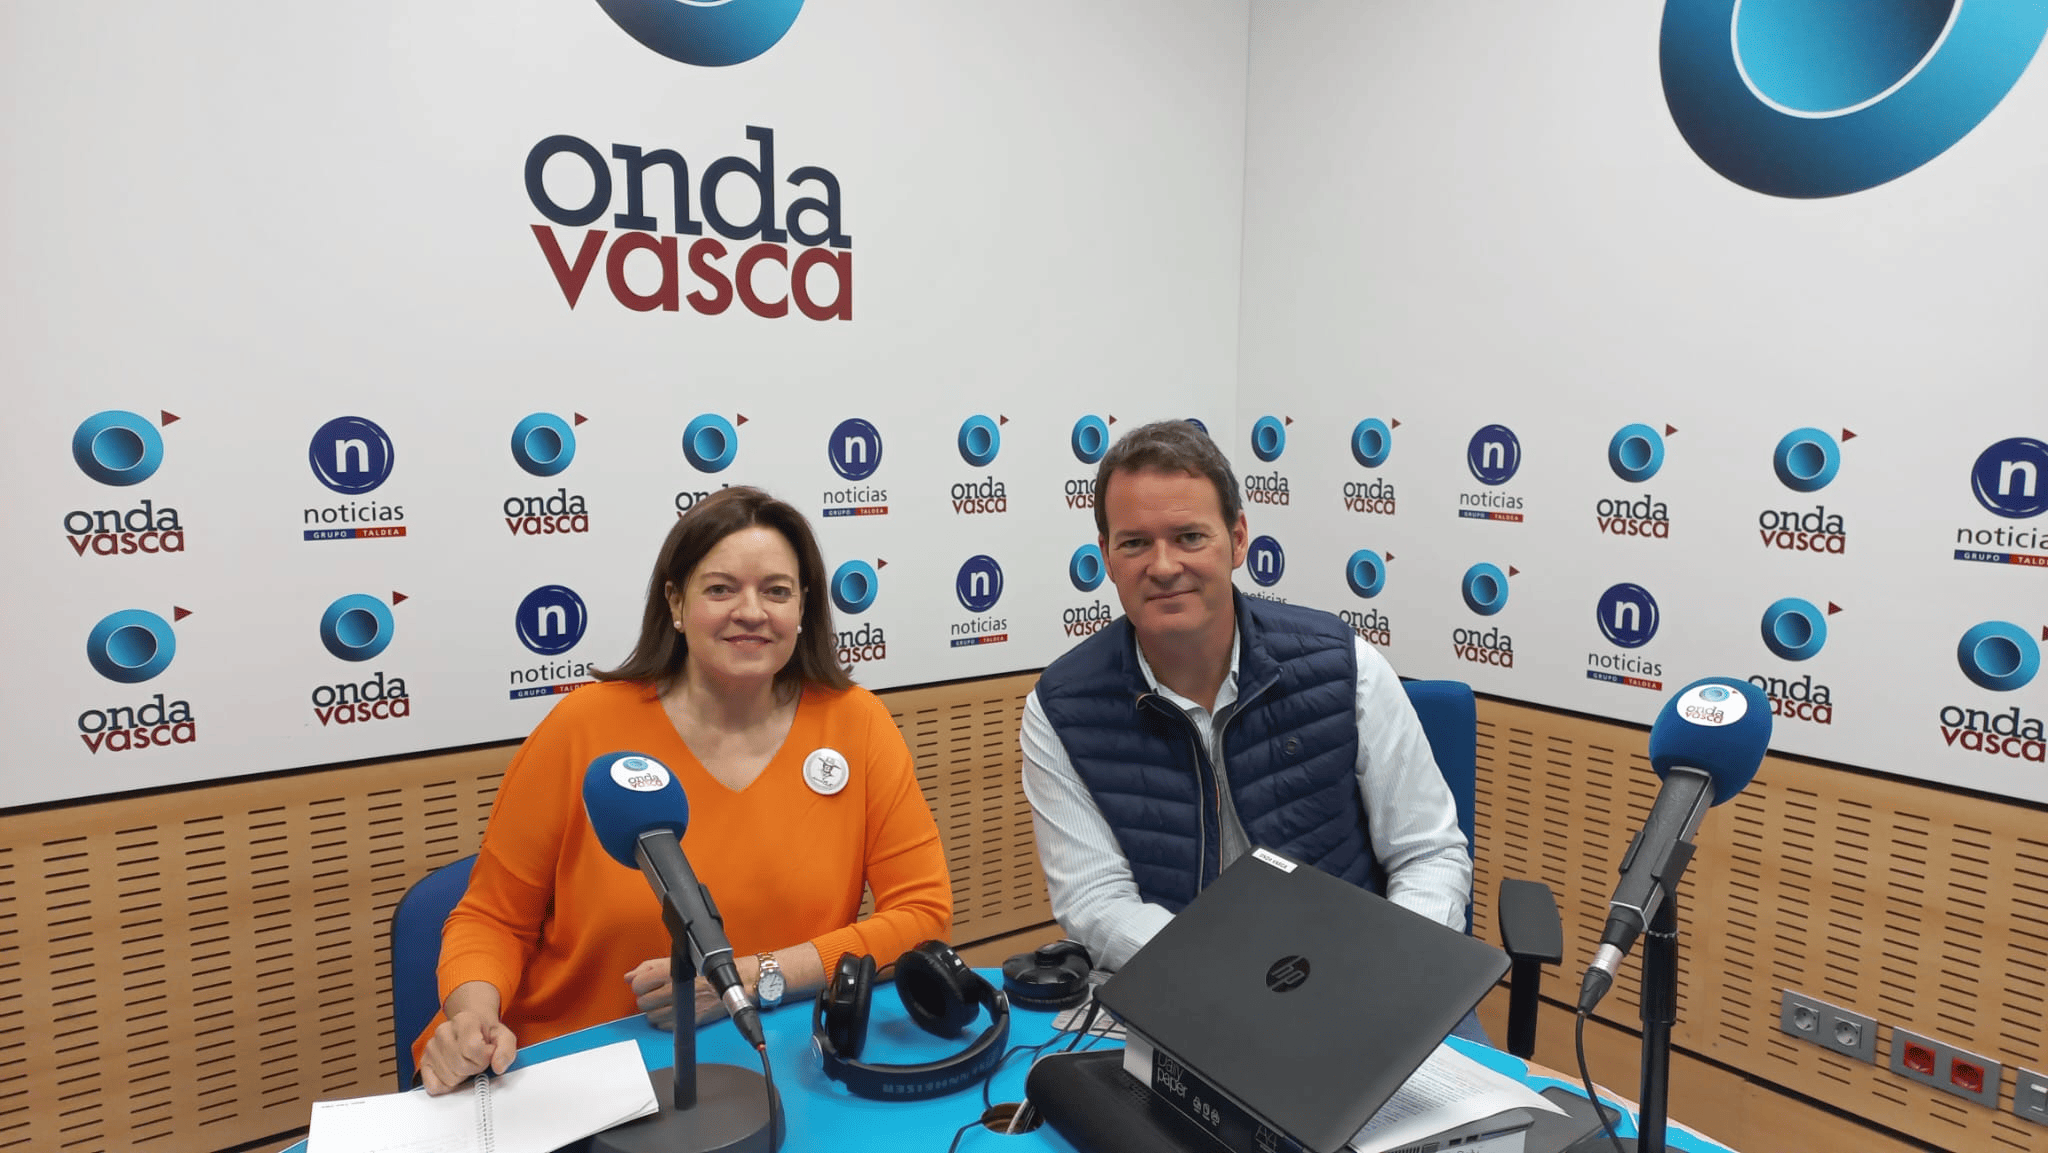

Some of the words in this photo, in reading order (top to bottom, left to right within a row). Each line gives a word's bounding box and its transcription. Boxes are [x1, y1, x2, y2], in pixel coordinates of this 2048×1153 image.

[525, 125, 851, 249] onda
[530, 224, 852, 321] vasca
[335, 438, 370, 473] n
[844, 434, 867, 464] n
[1482, 441, 1505, 469] n
[951, 476, 1006, 501] onda
[1244, 471, 1290, 494] onda
[1343, 478, 1396, 501] onda
[1998, 460, 2038, 497] n
[503, 488, 588, 518] onda
[823, 485, 888, 504] noticias
[952, 497, 1007, 515] vasca
[1065, 494, 1095, 510] vas
[1245, 490, 1290, 506] vasca
[1344, 496, 1396, 516] vasca
[1460, 490, 1524, 509] noticias
[64, 499, 183, 536] onda
[303, 501, 404, 524] noticias
[1596, 494, 1670, 522] onda
[1759, 505, 1846, 536] onda
[312, 530, 348, 540] GRUPO
[362, 528, 400, 537] TALDEA
[505, 513, 589, 536] vasca
[1597, 516, 1670, 539] vasca
[67, 530, 184, 556] vasca
[1760, 529, 1846, 554] vasca
[1957, 525, 2048, 550] noticia
[1257, 549, 1274, 574] n
[1963, 552, 2000, 562] GRUPO
[2018, 556, 2048, 566] TALD
[970, 569, 990, 597] n
[537, 604, 566, 637] n
[1062, 599, 1112, 624] onda
[1614, 601, 1641, 632] n
[951, 616, 1008, 636] noticias
[1356, 628, 1391, 648] sca
[1452, 626, 1514, 653] onda
[838, 644, 887, 664] asca
[1453, 643, 1514, 669] vasca
[1588, 652, 1663, 677] noticias
[311, 671, 409, 708] onda
[517, 688, 547, 697] GRUPO
[1592, 672, 1618, 682] GRUPO
[1628, 678, 1657, 689] TALDEA
[77, 693, 194, 735] onda
[313, 698, 410, 727] vasca
[1685, 704, 1725, 717] onda
[1768, 696, 1833, 725] asca
[1939, 705, 2047, 742] onda
[80, 721, 196, 755] vasca
[1941, 726, 2047, 763] vasca
[628, 772, 660, 784] onda
[1156, 1067, 1188, 1099] paper
